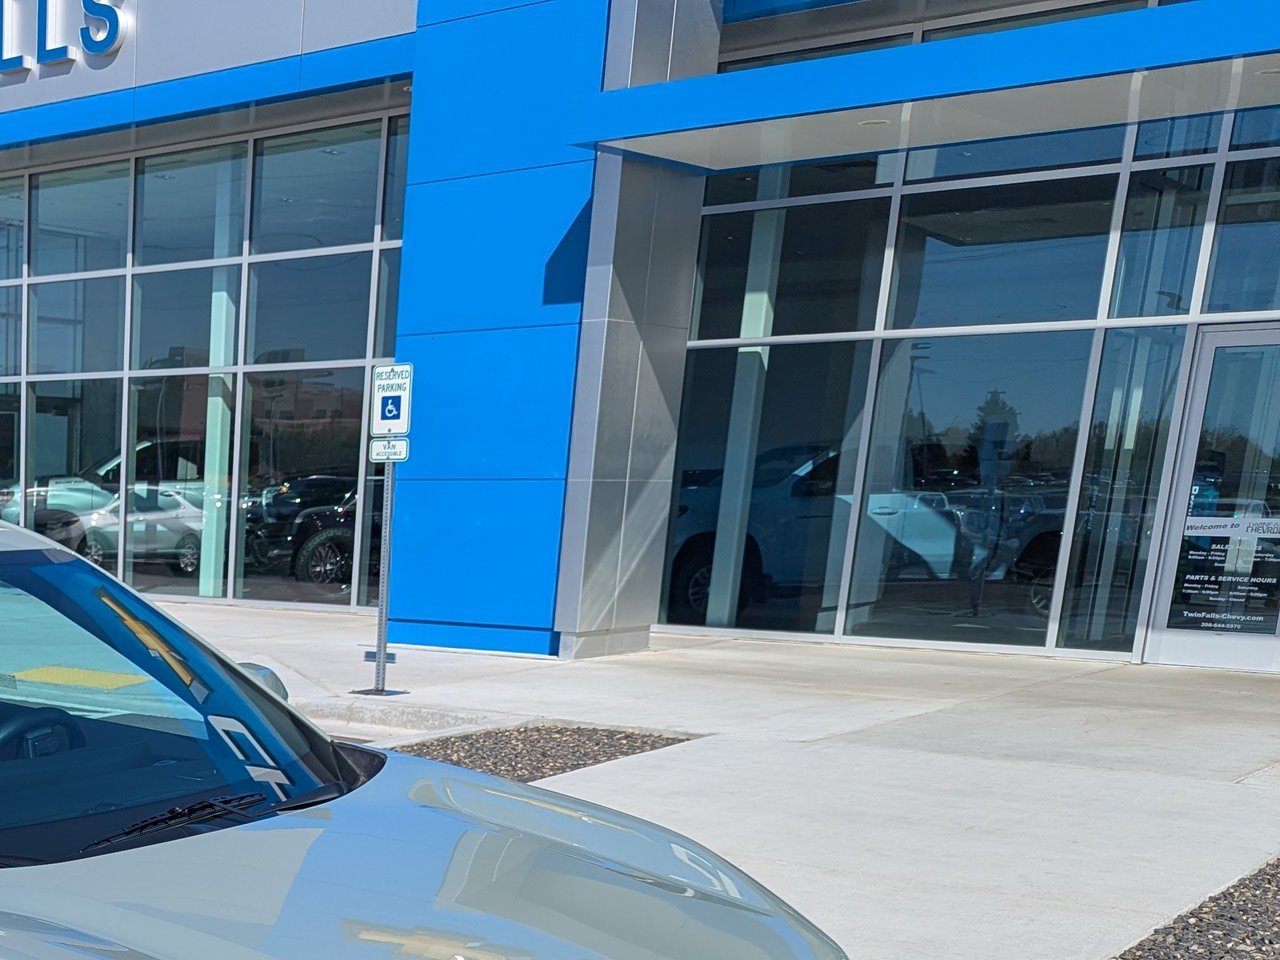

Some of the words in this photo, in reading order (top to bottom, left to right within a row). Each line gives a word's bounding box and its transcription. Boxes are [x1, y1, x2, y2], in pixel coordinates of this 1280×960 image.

[376, 370, 410, 381] RESERVED
[377, 382, 407, 393] PARKING
[1186, 523, 1228, 531] Welcome
[1183, 611, 1264, 621] TwinFalls-Chevy.com
